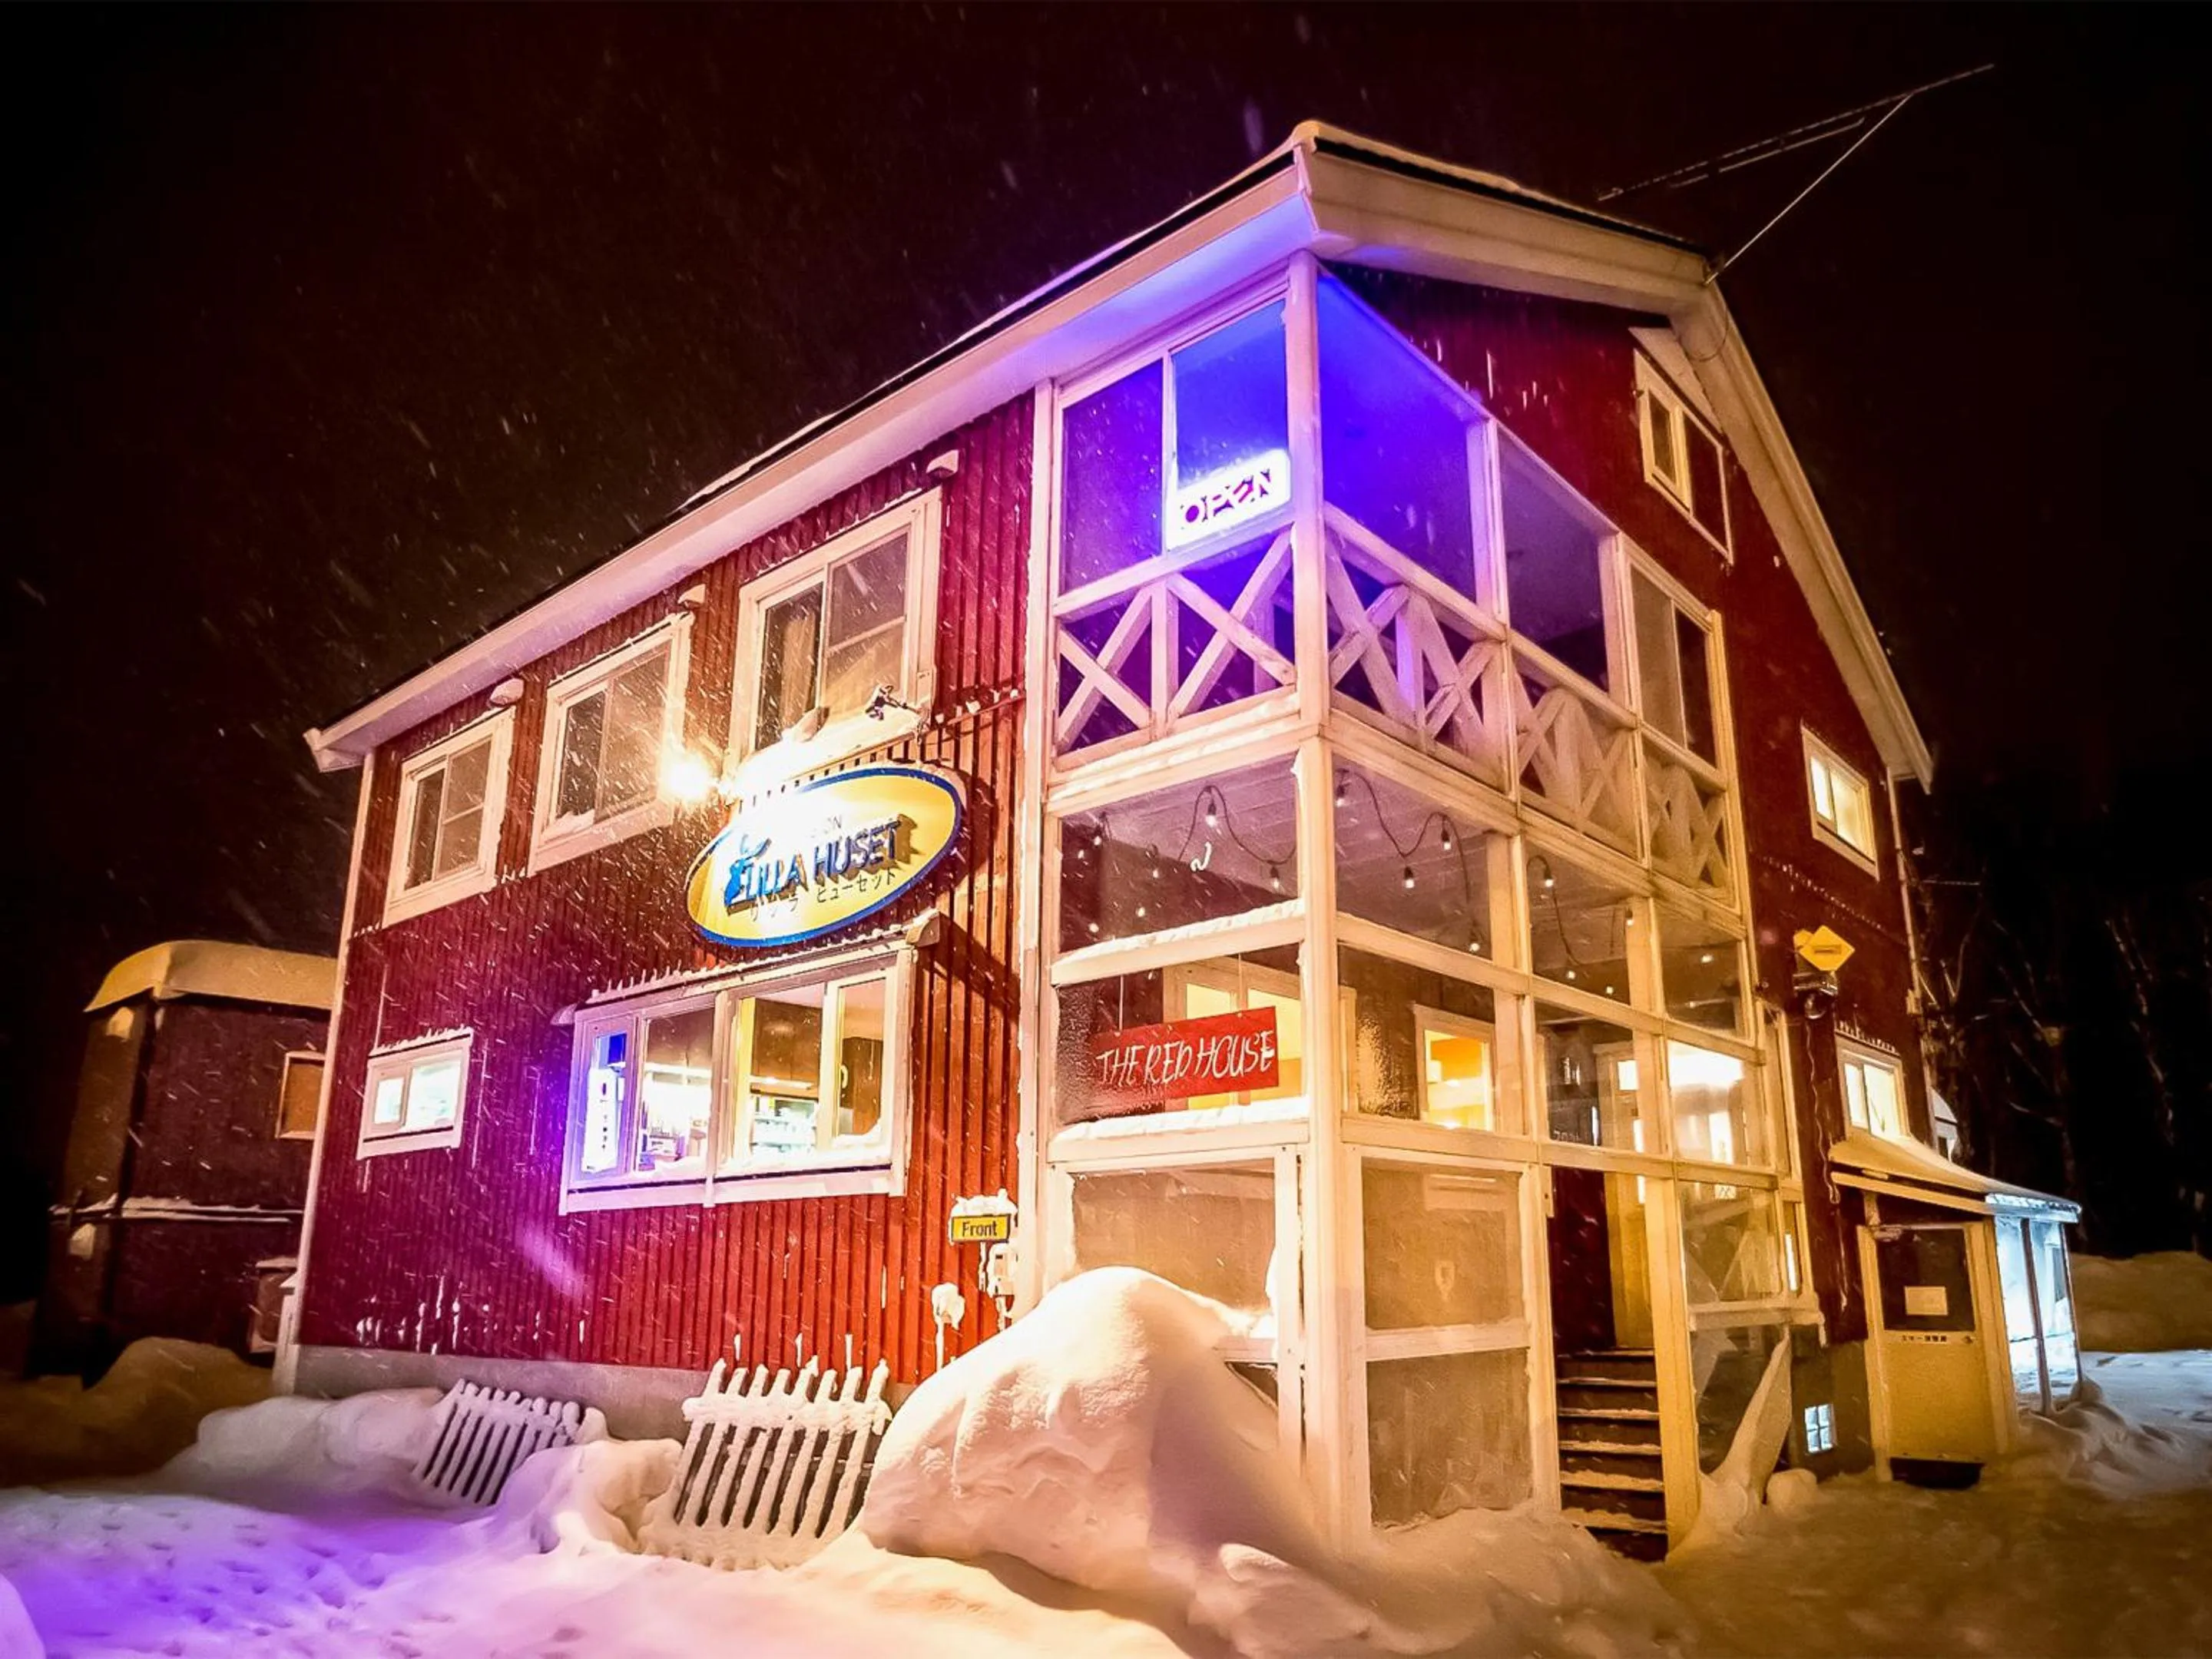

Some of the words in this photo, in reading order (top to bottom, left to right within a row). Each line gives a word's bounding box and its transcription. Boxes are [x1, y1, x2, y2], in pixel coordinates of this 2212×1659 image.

[813, 820, 902, 882] HUSET
[816, 868, 896, 902] ヒューセット
[1096, 1044, 1145, 1088] THE
[1144, 1039, 1193, 1085] RED
[1194, 1029, 1275, 1078] HOUSE
[962, 1220, 998, 1237] Front
